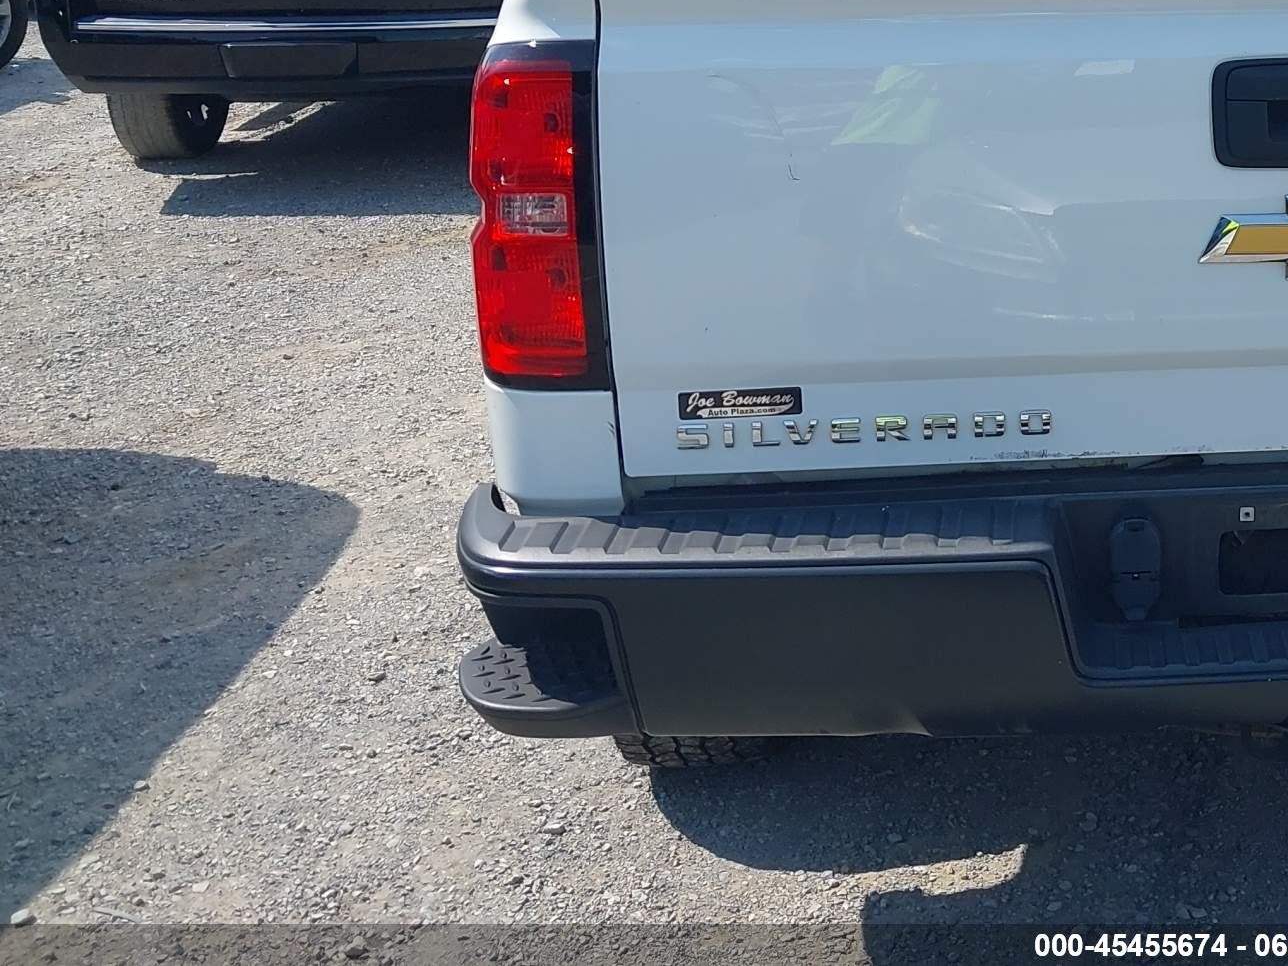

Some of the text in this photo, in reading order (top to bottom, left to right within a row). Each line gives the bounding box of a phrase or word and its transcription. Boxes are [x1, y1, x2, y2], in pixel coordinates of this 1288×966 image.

[686, 390, 794, 413] Joe Bowman
[707, 409, 729, 417] Auto
[676, 409, 1053, 450] SILVERADO
